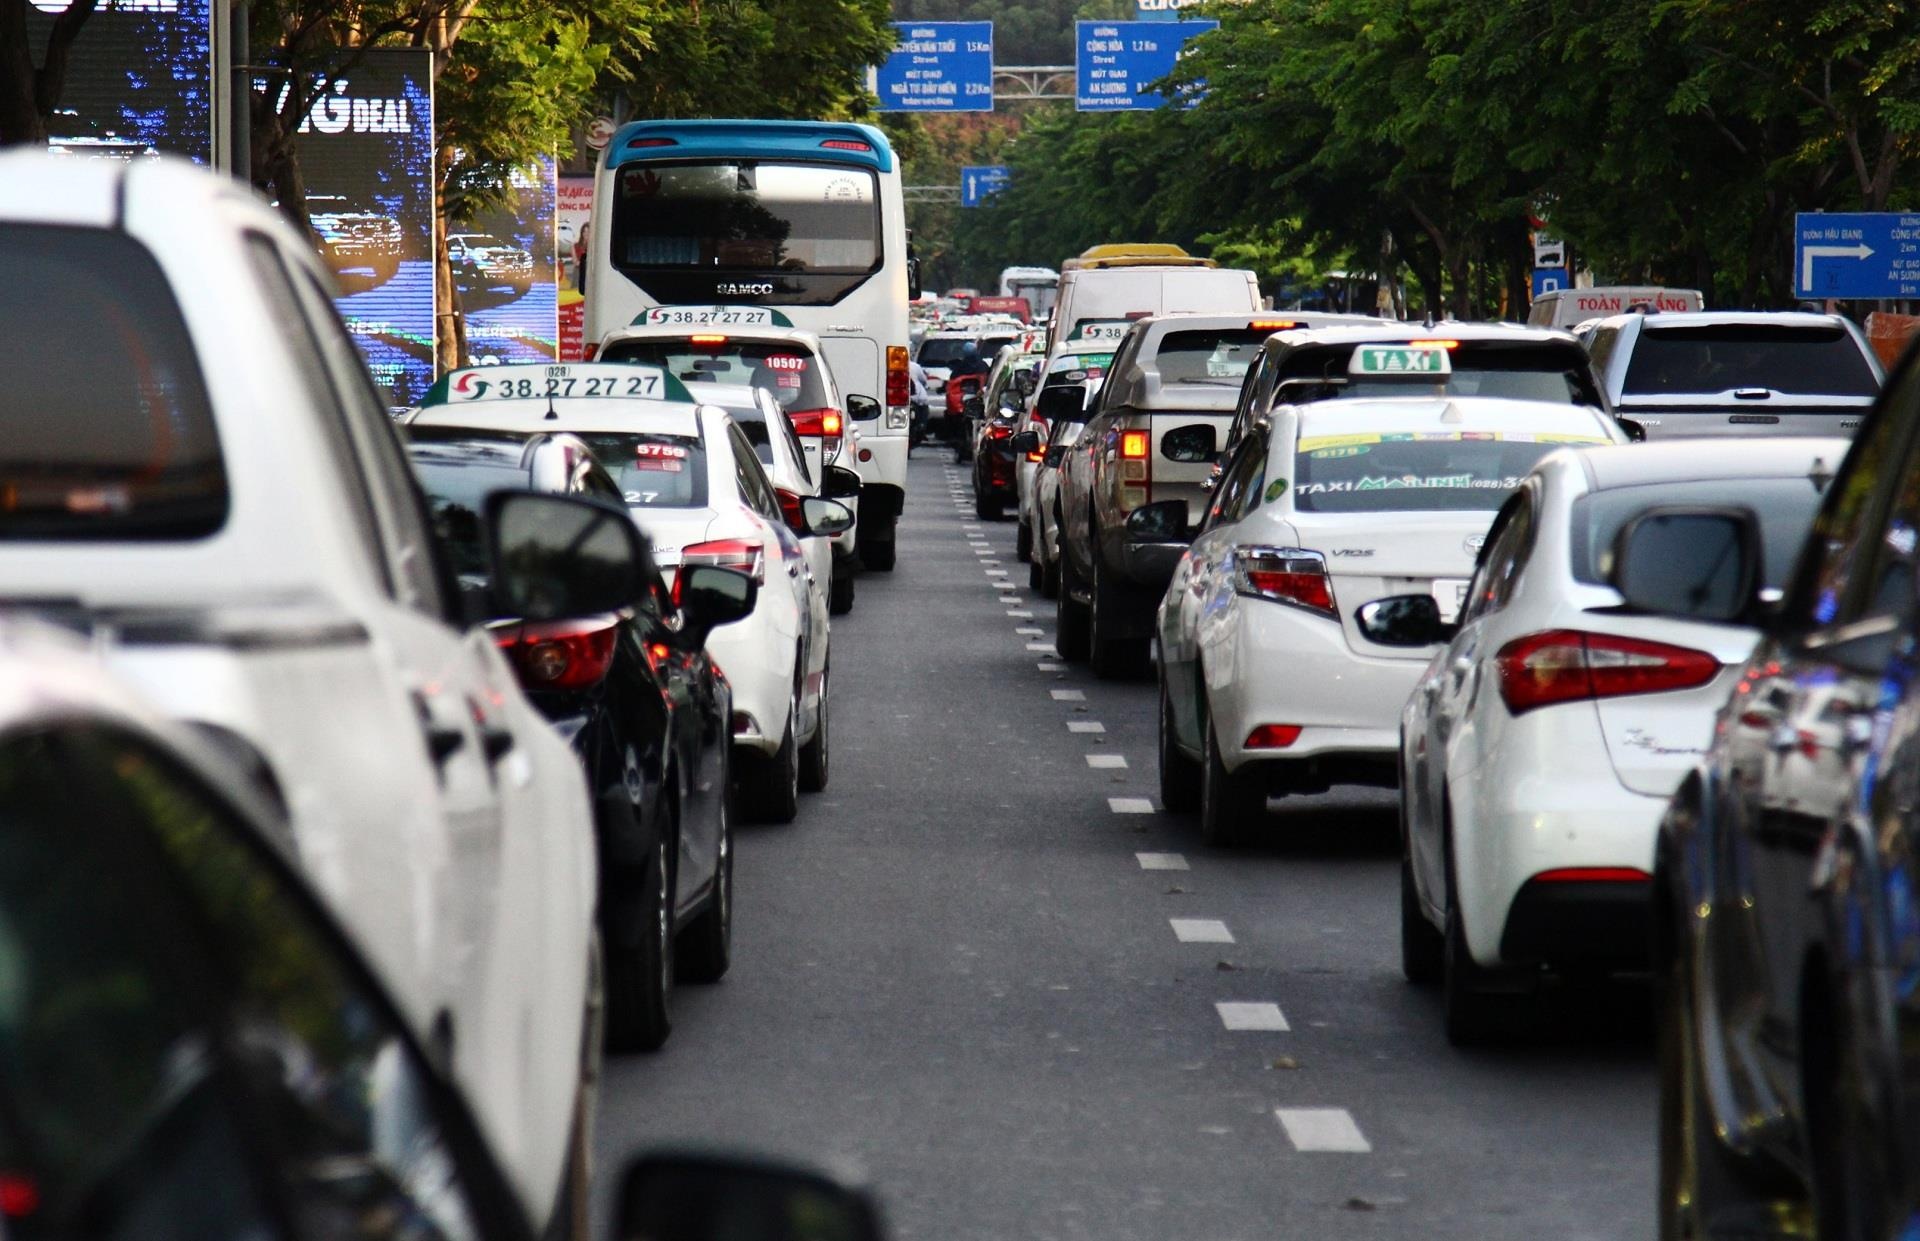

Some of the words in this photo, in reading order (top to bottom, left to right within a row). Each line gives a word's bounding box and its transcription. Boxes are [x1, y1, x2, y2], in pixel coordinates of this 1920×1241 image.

[1092, 56, 1116, 64] Street
[1079, 97, 1132, 106] Intersection
[352, 98, 412, 133] DEAL
[1824, 227, 1840, 241] HẬU
[1841, 230, 1863, 239] GIANG
[1888, 270, 1899, 281] AN
[1578, 294, 1621, 311] TOÀN
[674, 312, 718, 323] 38.27
[722, 312, 741, 323] 27
[746, 312, 765, 323] 27
[466, 327, 524, 338] EVEREST
[766, 356, 804, 370] 10507
[544, 366, 571, 378] (028)
[500, 378, 577, 399] 38.27
[585, 377, 618, 397] 27
[627, 376, 659, 396] 27
[637, 444, 686, 458] 5759
[1296, 481, 1353, 495] TAXI
[624, 491, 658, 503] 27
[1332, 549, 1376, 557] VIOS
